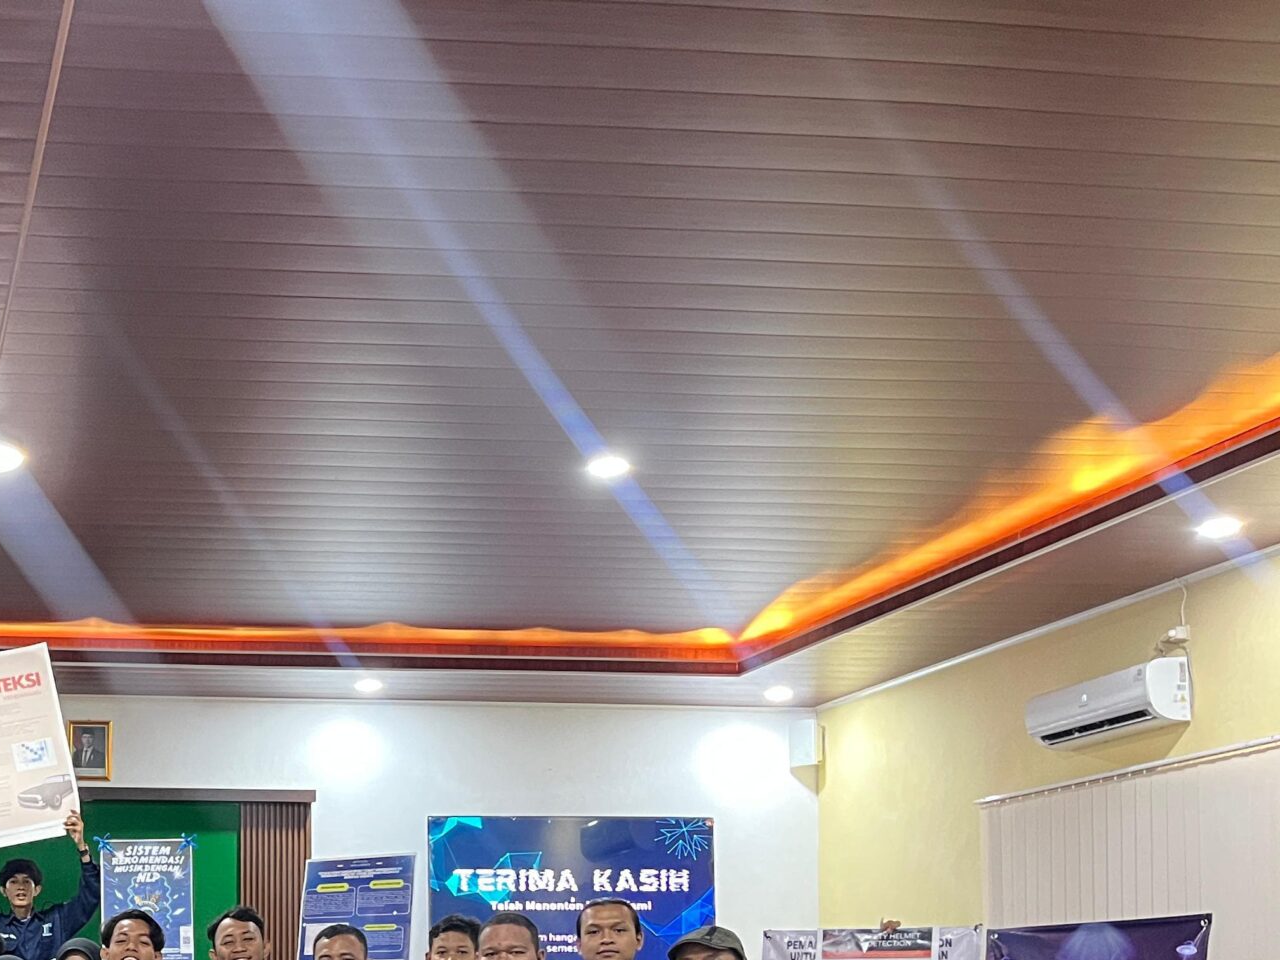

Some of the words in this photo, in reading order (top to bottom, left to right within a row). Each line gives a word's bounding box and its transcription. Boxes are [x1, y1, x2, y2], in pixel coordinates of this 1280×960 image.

[125, 846, 171, 855] SISTEM
[112, 856, 184, 865] REKOMENDASI
[114, 864, 144, 872] MUSIK
[136, 872, 160, 882] NLP
[453, 868, 579, 892] TERIMA
[593, 868, 690, 893] KASIH
[491, 901, 523, 911] Telah
[525, 900, 584, 911] Menonton
[547, 945, 578, 953] semes
[790, 952, 816, 960] UNTU
